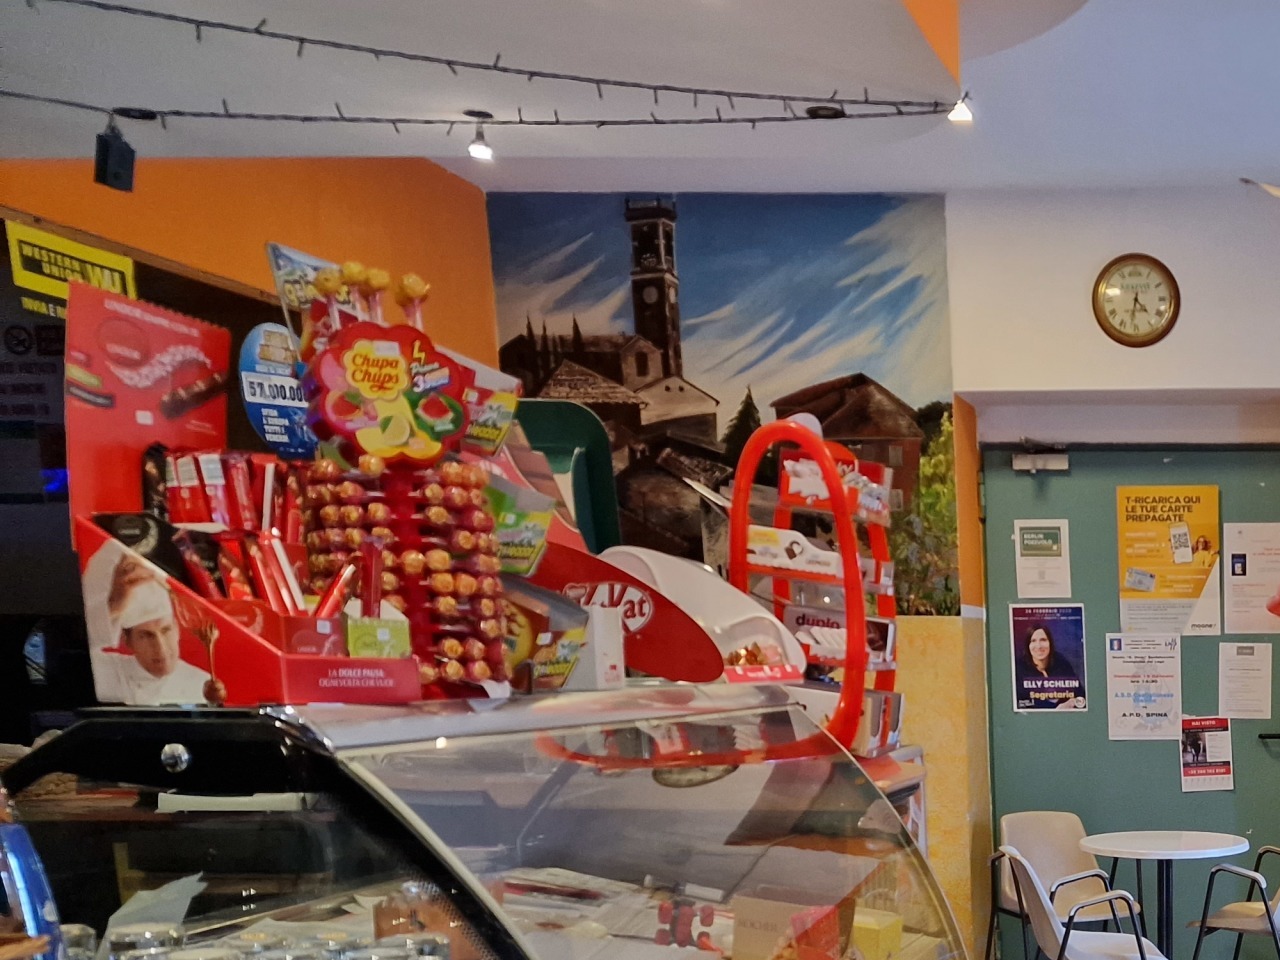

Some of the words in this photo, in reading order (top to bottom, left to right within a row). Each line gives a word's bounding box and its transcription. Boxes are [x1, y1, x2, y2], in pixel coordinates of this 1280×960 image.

[20, 243, 81, 273] WESTERN
[352, 353, 399, 370] Chupa
[352, 368, 399, 388] Chups
[1125, 496, 1181, 504] T-RICARICA
[1183, 496, 1201, 504] QUI
[1125, 505, 1137, 513] LE
[1140, 505, 1158, 513] TUE
[1160, 505, 1193, 513] CARTE
[1125, 514, 1185, 522] PREPAGATE
[795, 613, 840, 629] duplo
[1023, 680, 1042, 689] ELLY
[1043, 680, 1080, 688] SCHLEIN
[1029, 691, 1075, 700] Segretaria
